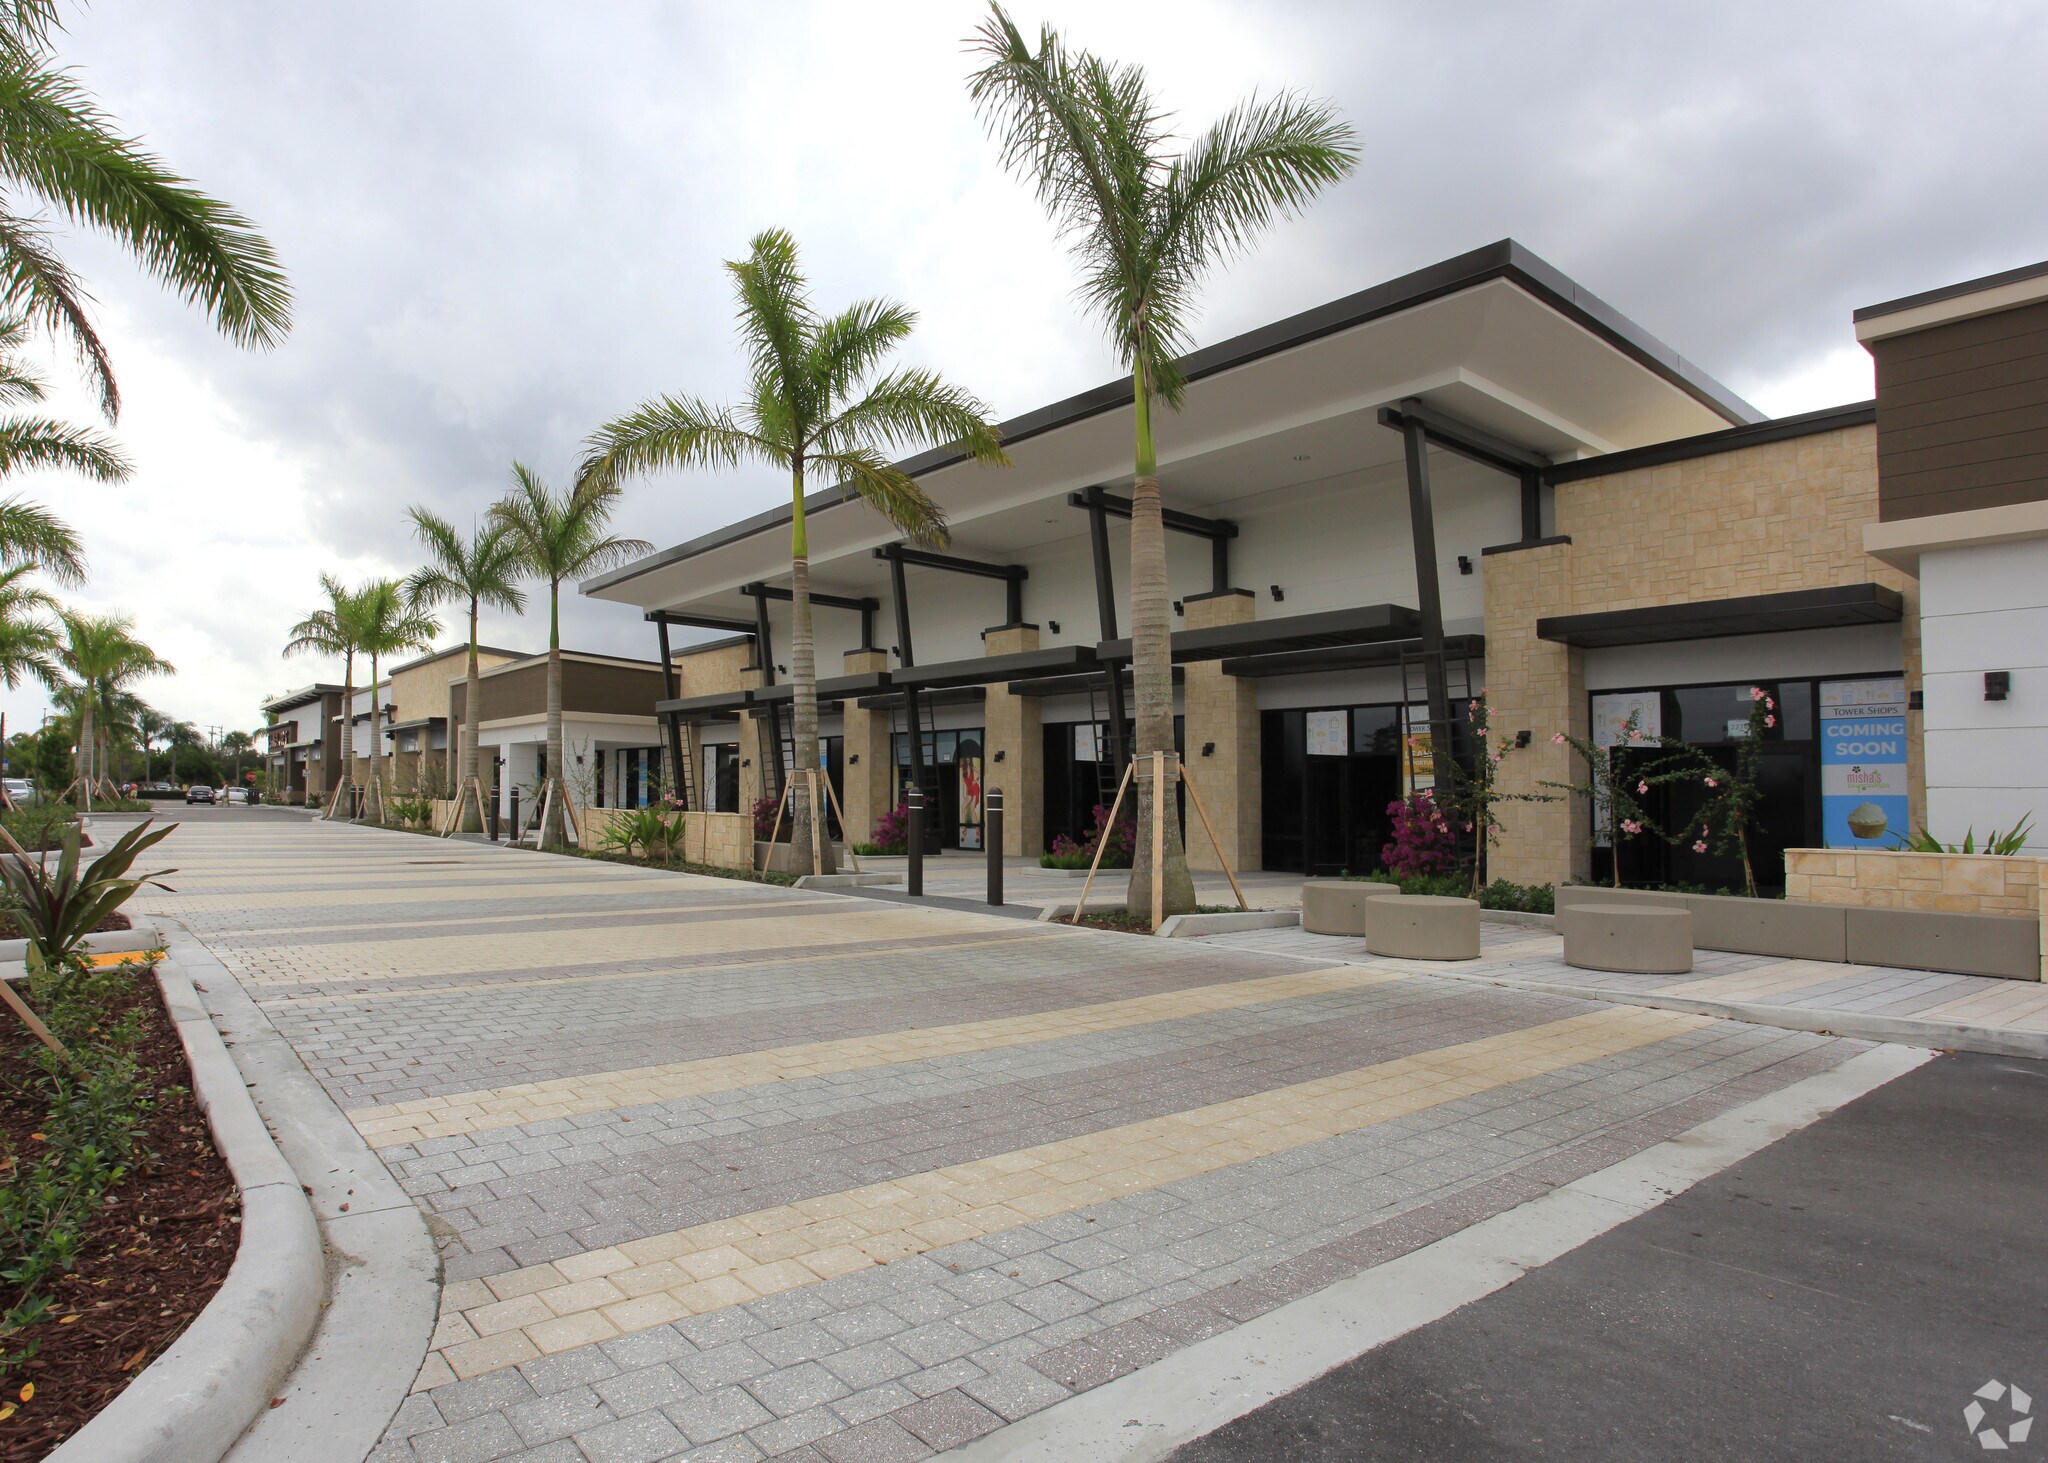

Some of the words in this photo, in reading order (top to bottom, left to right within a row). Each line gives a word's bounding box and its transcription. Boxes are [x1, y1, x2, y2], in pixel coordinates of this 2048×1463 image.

[1833, 708, 1865, 716] TOWER
[1867, 706, 1898, 715] SHOPS
[1827, 723, 1904, 737] COMING
[1835, 741, 1897, 756] SOON
